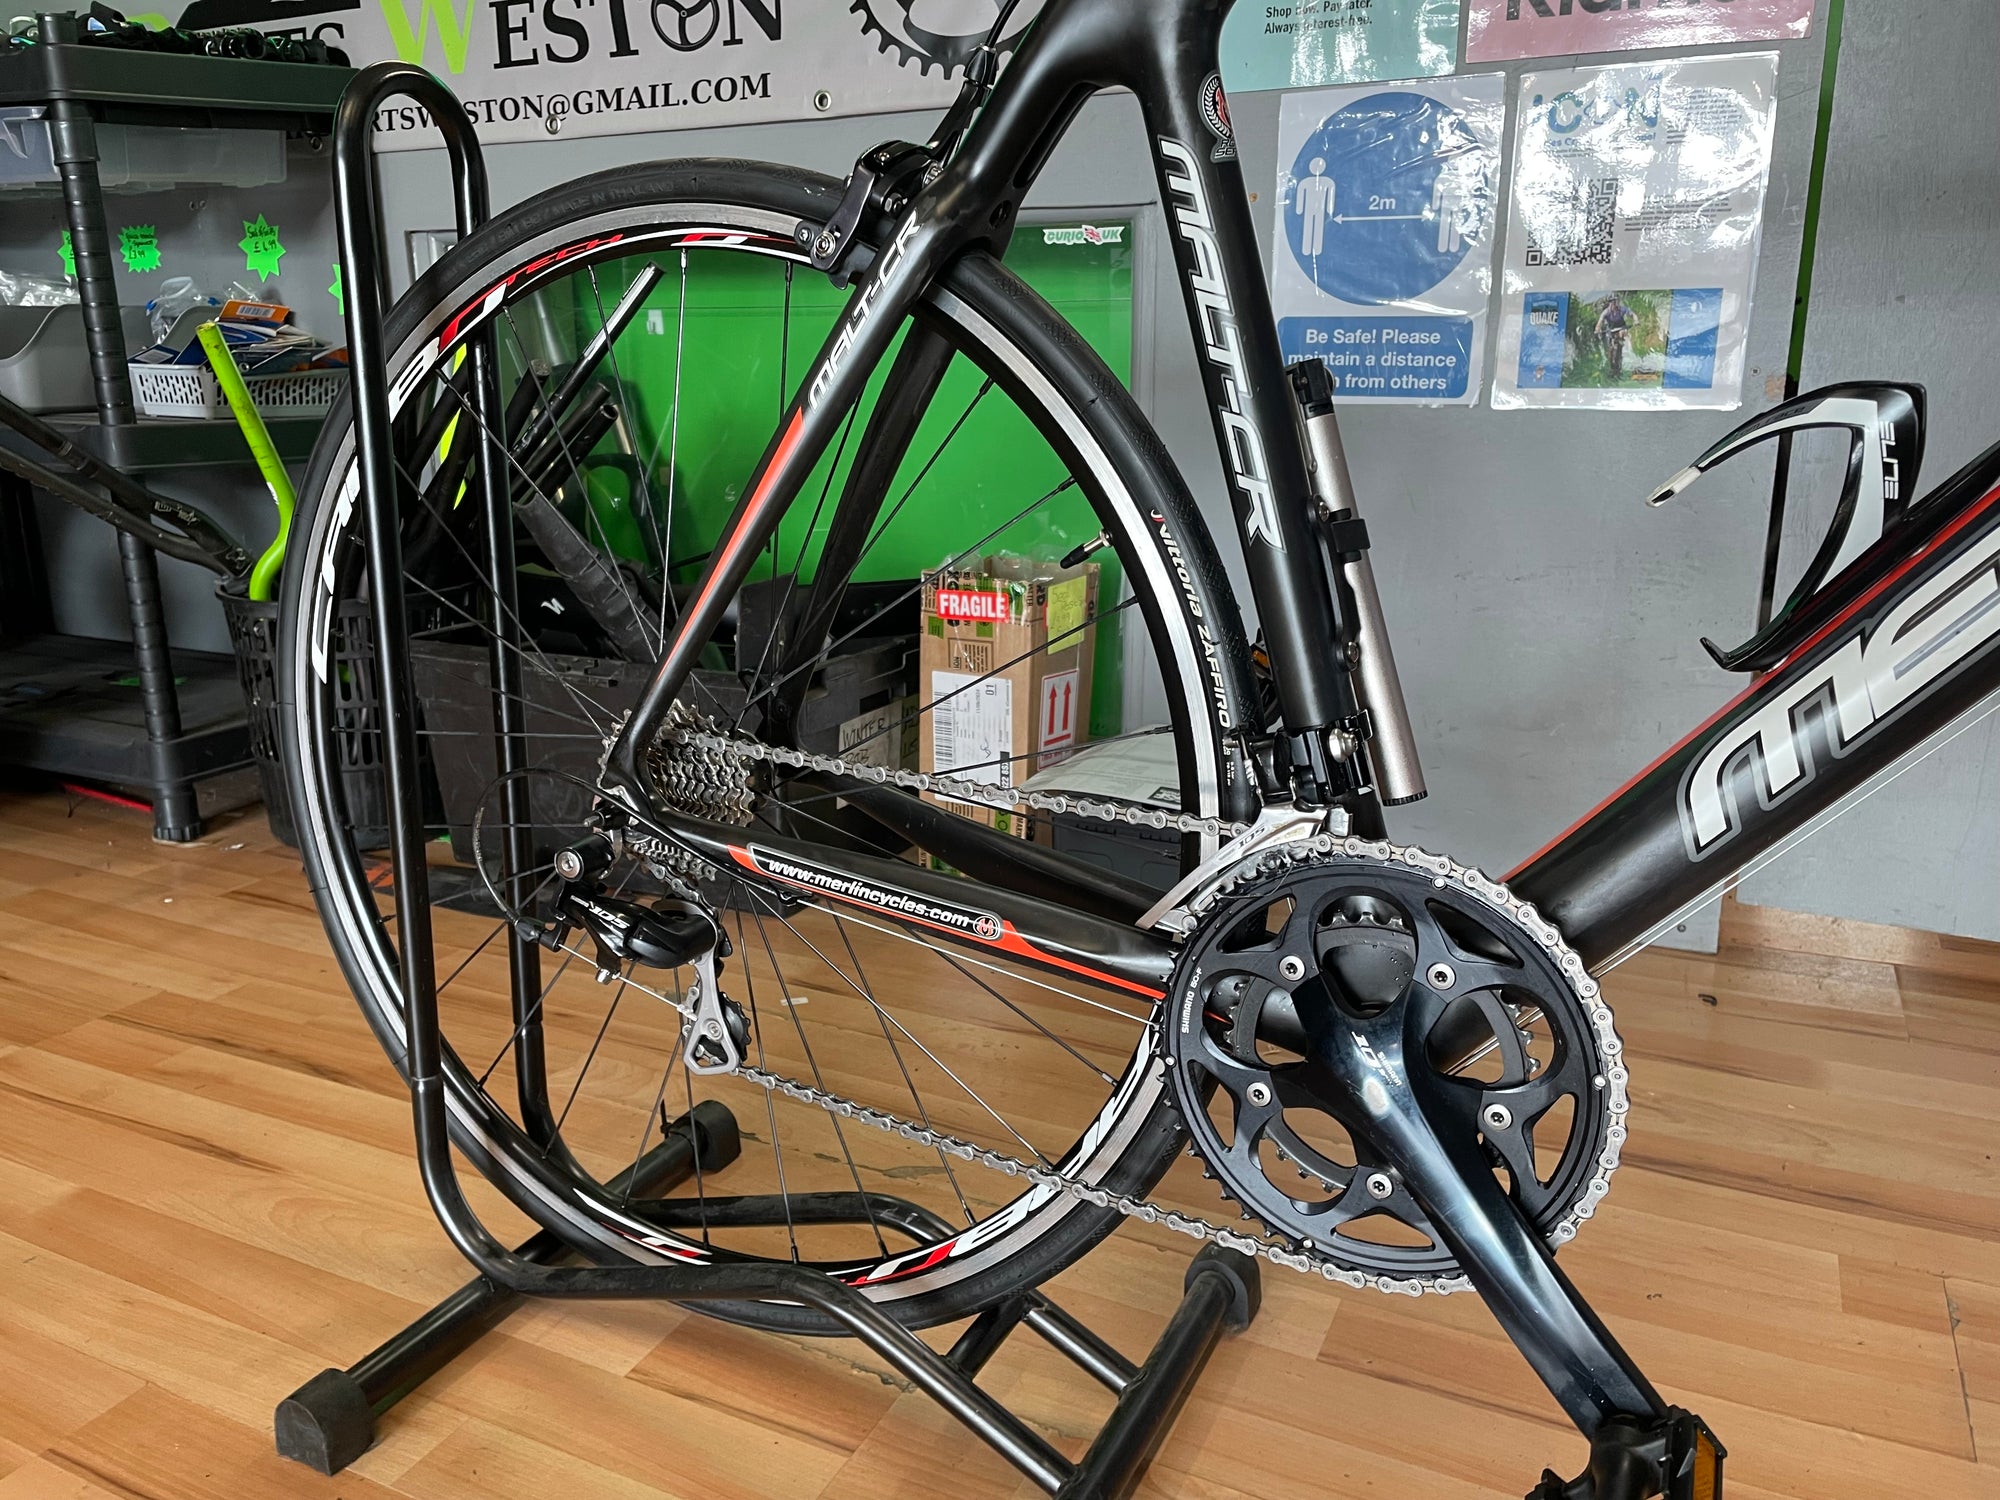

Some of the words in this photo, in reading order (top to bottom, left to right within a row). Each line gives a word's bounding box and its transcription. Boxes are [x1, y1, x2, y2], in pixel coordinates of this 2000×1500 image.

[1265, 6, 1292, 18] Shop
[1323, 0, 1341, 13] Pay
[1264, 22, 1300, 35] Always
[370, 72, 772, 133] RTSWSTON@GMAIL.COM
[1368, 194, 1396, 210] 2m
[1102, 229, 1119, 240] UK
[808, 208, 922, 412] MALT-CR
[1529, 311, 1559, 326] QUAKE
[1160, 136, 1286, 551] MALT-CR
[1306, 329, 1329, 344] Be
[1333, 328, 1377, 345] Safe!
[1381, 329, 1441, 344] Please
[1364, 354, 1376, 367] a
[1380, 351, 1457, 368] distance
[1344, 373, 1385, 389] from
[1390, 374, 1448, 390] others
[938, 592, 1007, 619] FRAGILE
[1158, 524, 1204, 620] Vittoria
[1197, 625, 1232, 729] ZAFFIRO
[768, 857, 970, 928] www.merlincycles.com
[588, 900, 631, 930] 105
[1181, 989, 1195, 1036] SHIMANO
